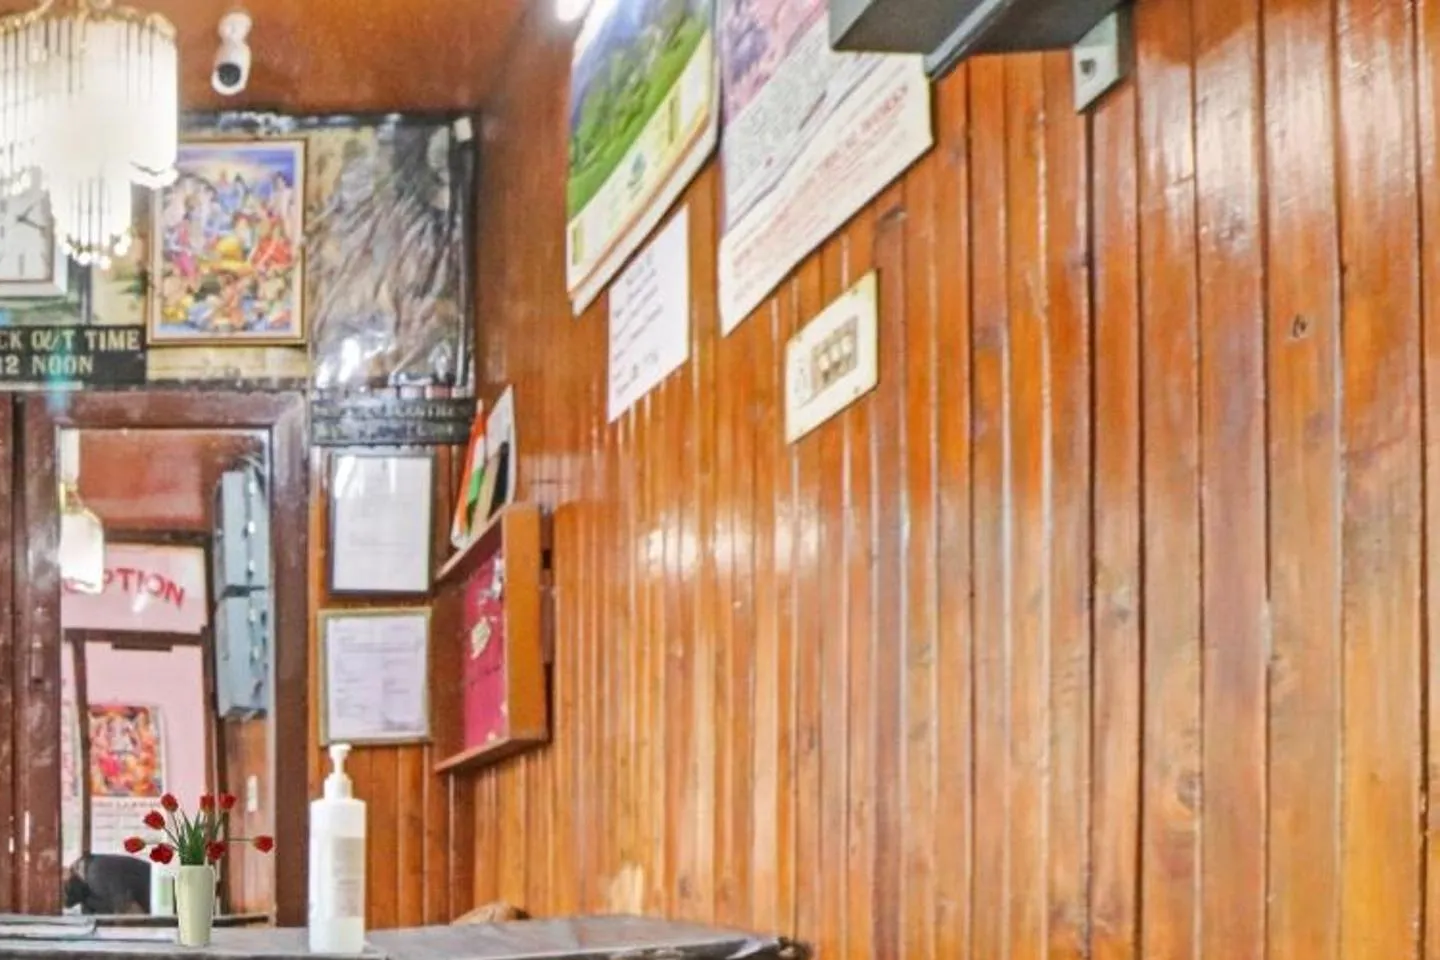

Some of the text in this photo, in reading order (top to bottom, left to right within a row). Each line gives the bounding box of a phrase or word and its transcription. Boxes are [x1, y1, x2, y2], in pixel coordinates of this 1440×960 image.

[30, 329, 76, 350] OUT
[84, 328, 141, 351] TIME
[31, 354, 94, 376] NOON
[101, 567, 185, 609] PTION
